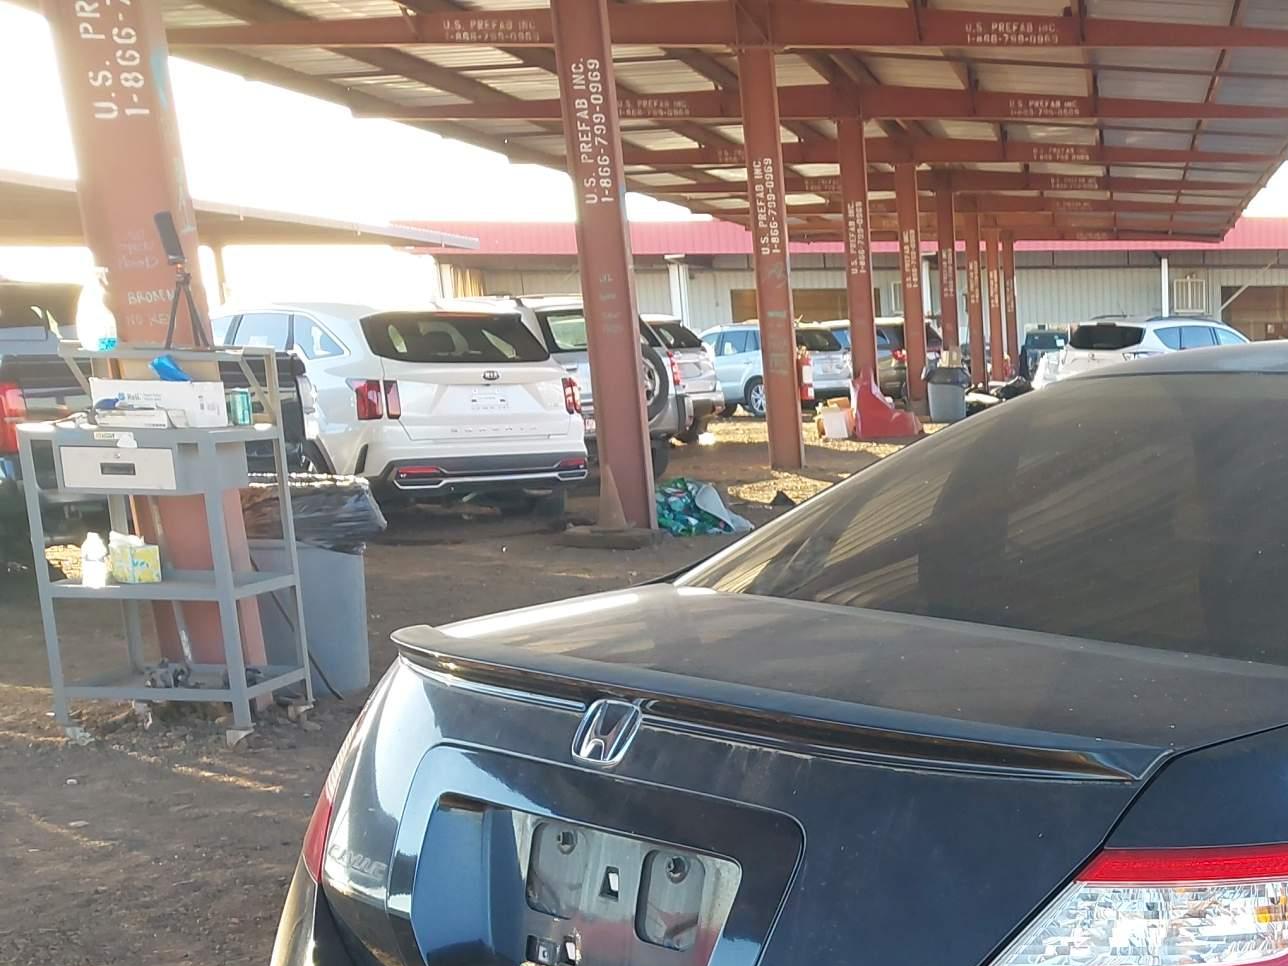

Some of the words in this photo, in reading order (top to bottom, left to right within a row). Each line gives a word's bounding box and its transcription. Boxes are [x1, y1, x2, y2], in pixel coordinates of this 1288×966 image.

[88, 60, 119, 119] U.S.
[571, 57, 586, 90] INC.
[575, 98, 595, 163] PREFAB
[587, 58, 614, 203] 1-866-799-0969
[755, 184, 767, 228] PREFAB
[763, 157, 781, 254] 1-866-799-0969
